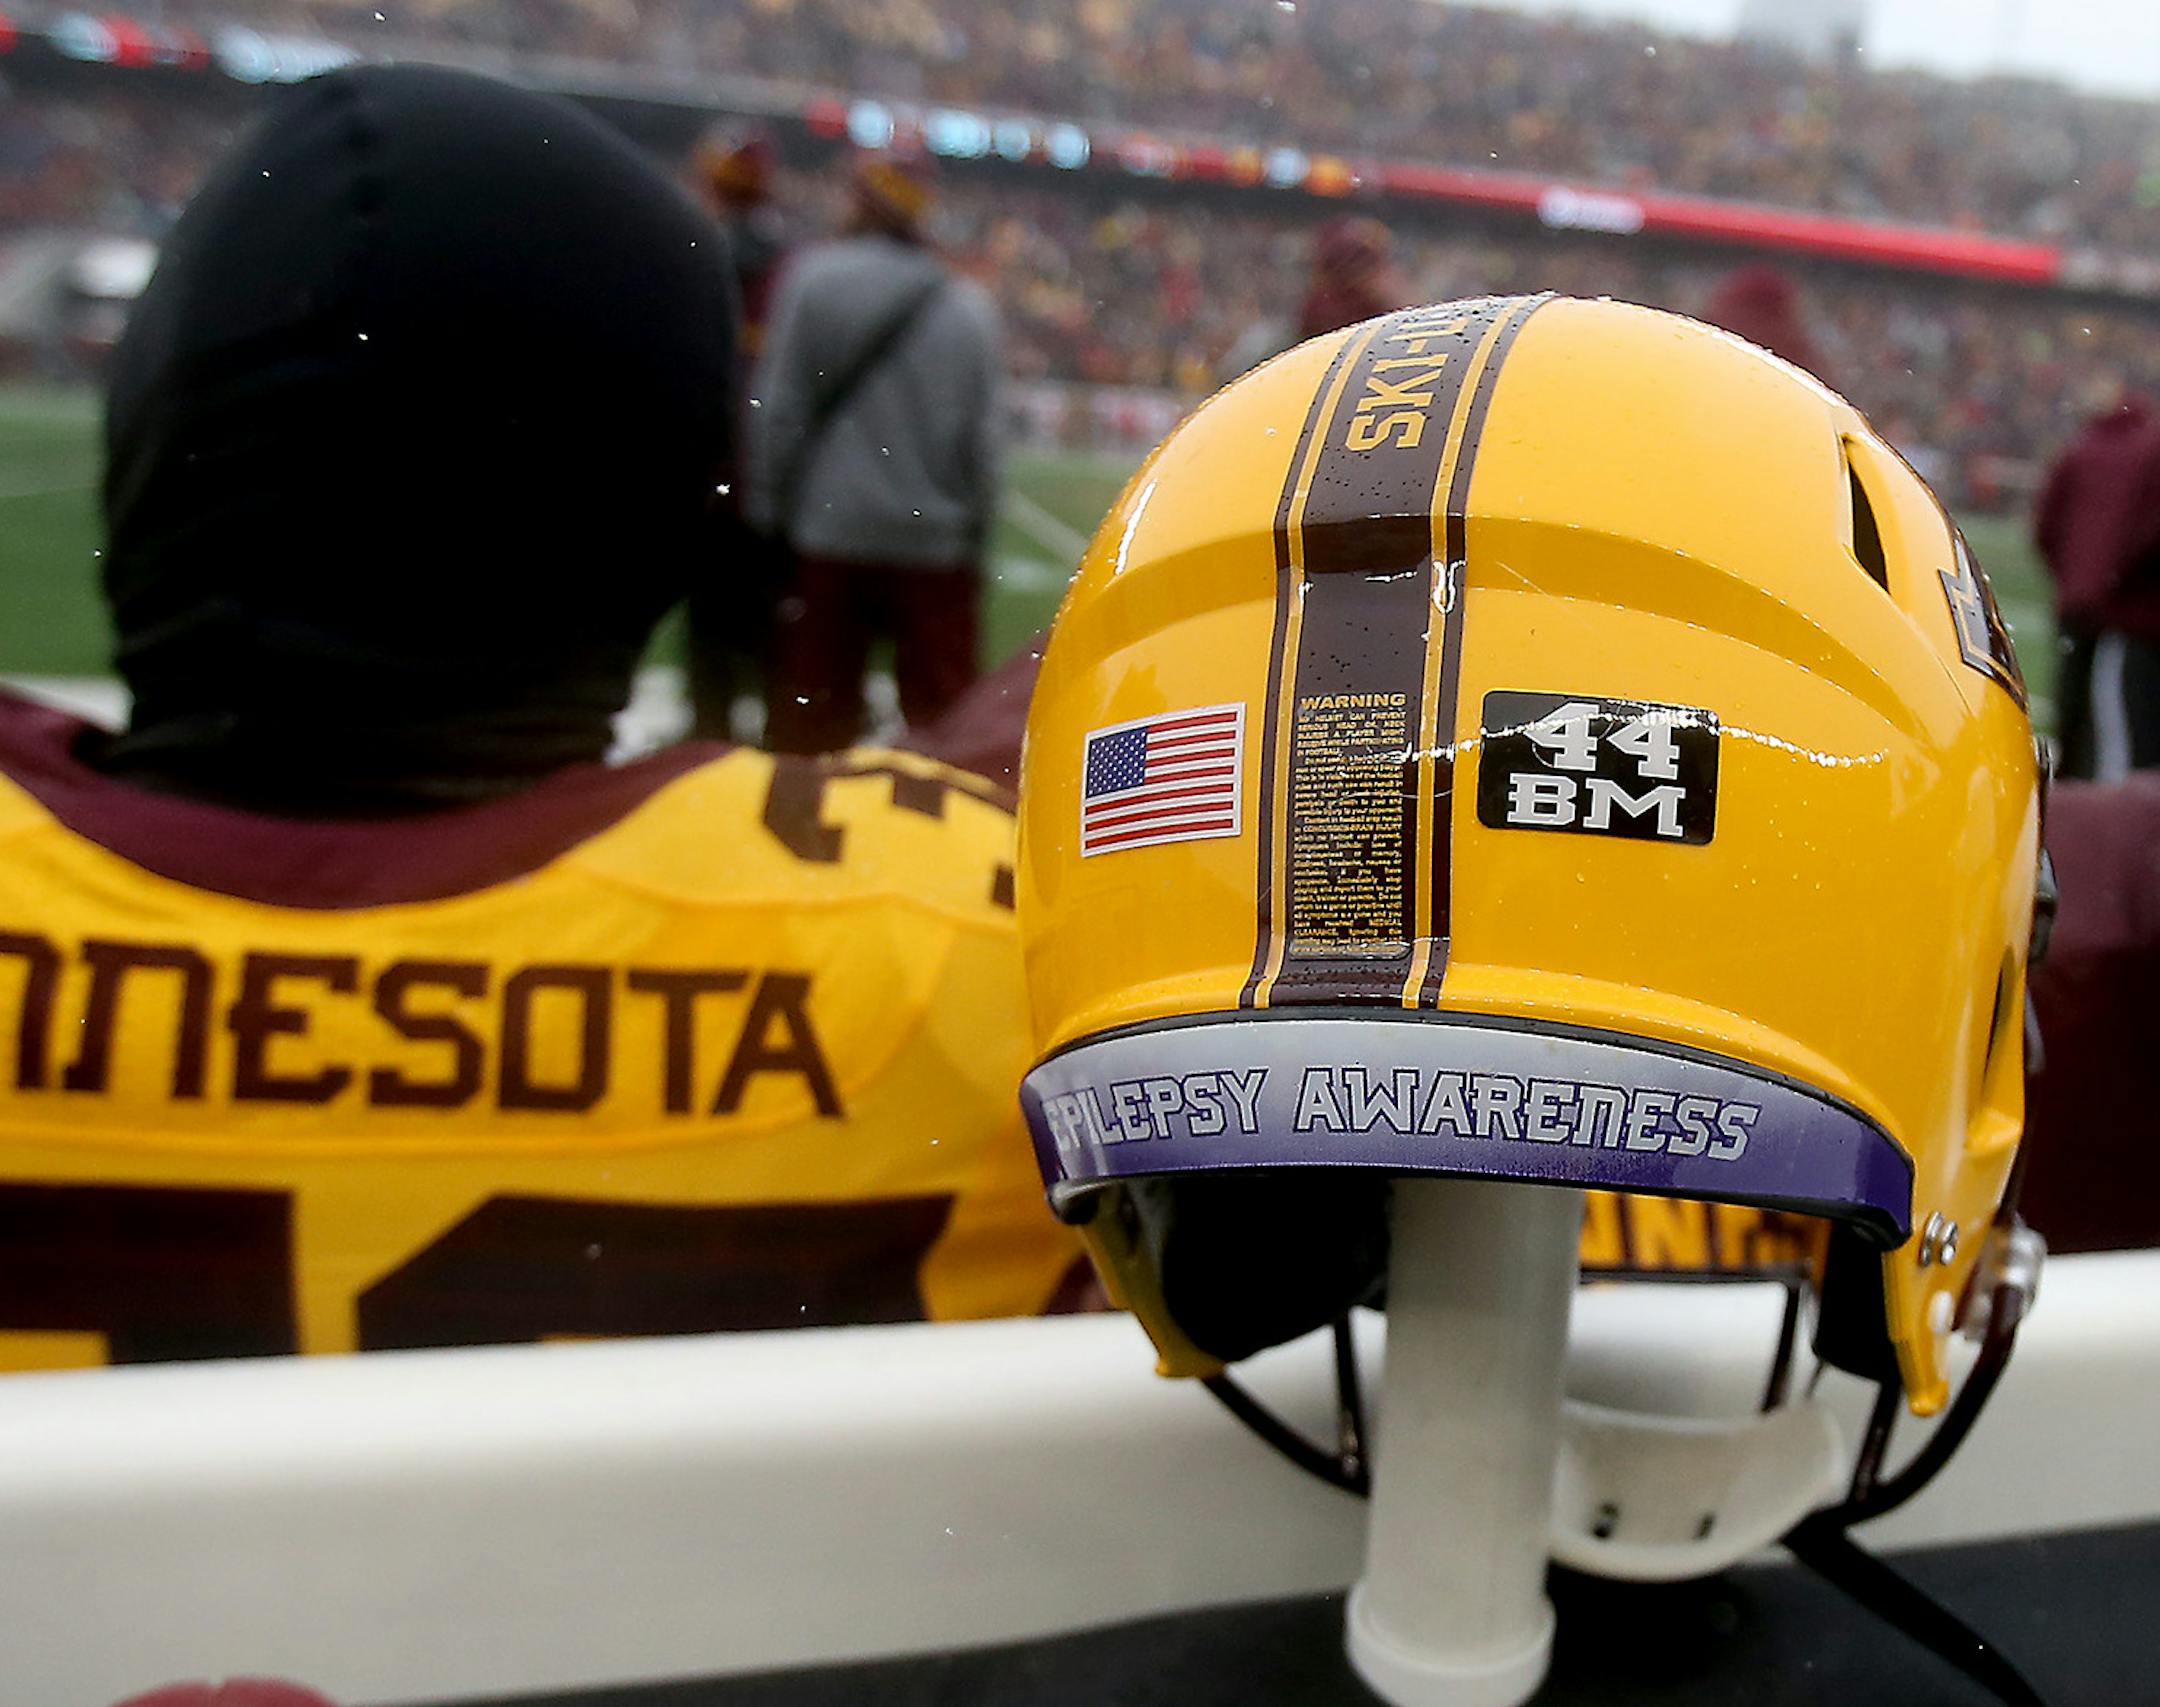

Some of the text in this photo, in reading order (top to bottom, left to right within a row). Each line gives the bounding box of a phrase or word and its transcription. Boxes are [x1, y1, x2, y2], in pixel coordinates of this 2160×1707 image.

[1300, 693, 1407, 711] WARNING
[1523, 701, 1682, 781] 44
[1507, 772, 1687, 838] BM
[1041, 1065, 1763, 1162] EPILEPSY AWARENESS
